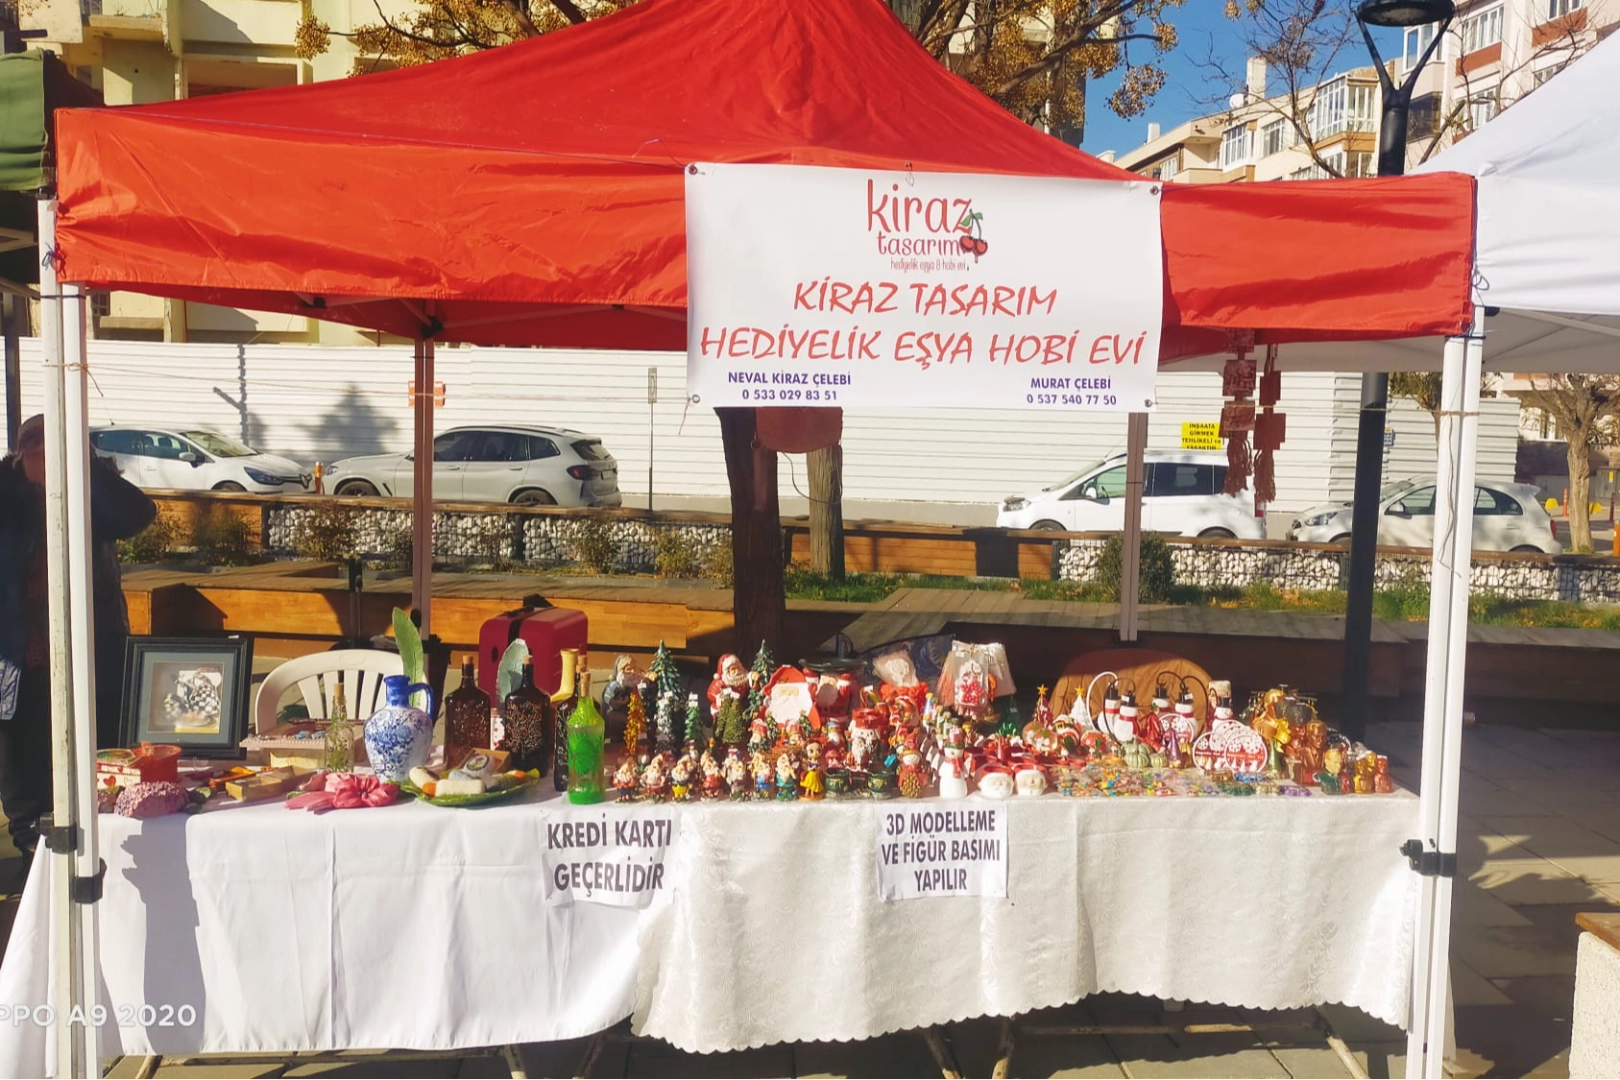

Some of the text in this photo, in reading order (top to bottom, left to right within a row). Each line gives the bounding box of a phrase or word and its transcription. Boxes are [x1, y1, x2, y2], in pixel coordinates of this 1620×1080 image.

[867, 178, 973, 233] kiraz
[876, 231, 961, 256] tasarım
[794, 276, 1057, 317] KİRAZ TASARIM
[700, 323, 1147, 371] HEDİYELİK EŞYA HOBİ EVİ
[728, 369, 851, 388] NEVAL KİRAZ ÇELEBİ
[1030, 375, 1111, 392] MURAT ÇELEBİ
[742, 389, 837, 401] 0 533 029 83 51
[1026, 394, 1117, 405] 0 537 540 77 50
[547, 812, 672, 849] KREDİ KARTI
[886, 810, 995, 836] 3D MODELLEME
[881, 834, 1000, 865] VE FİGÜR BASIMI
[554, 856, 665, 897] GEÇERLİDİR
[914, 868, 968, 892] YAPILIR
